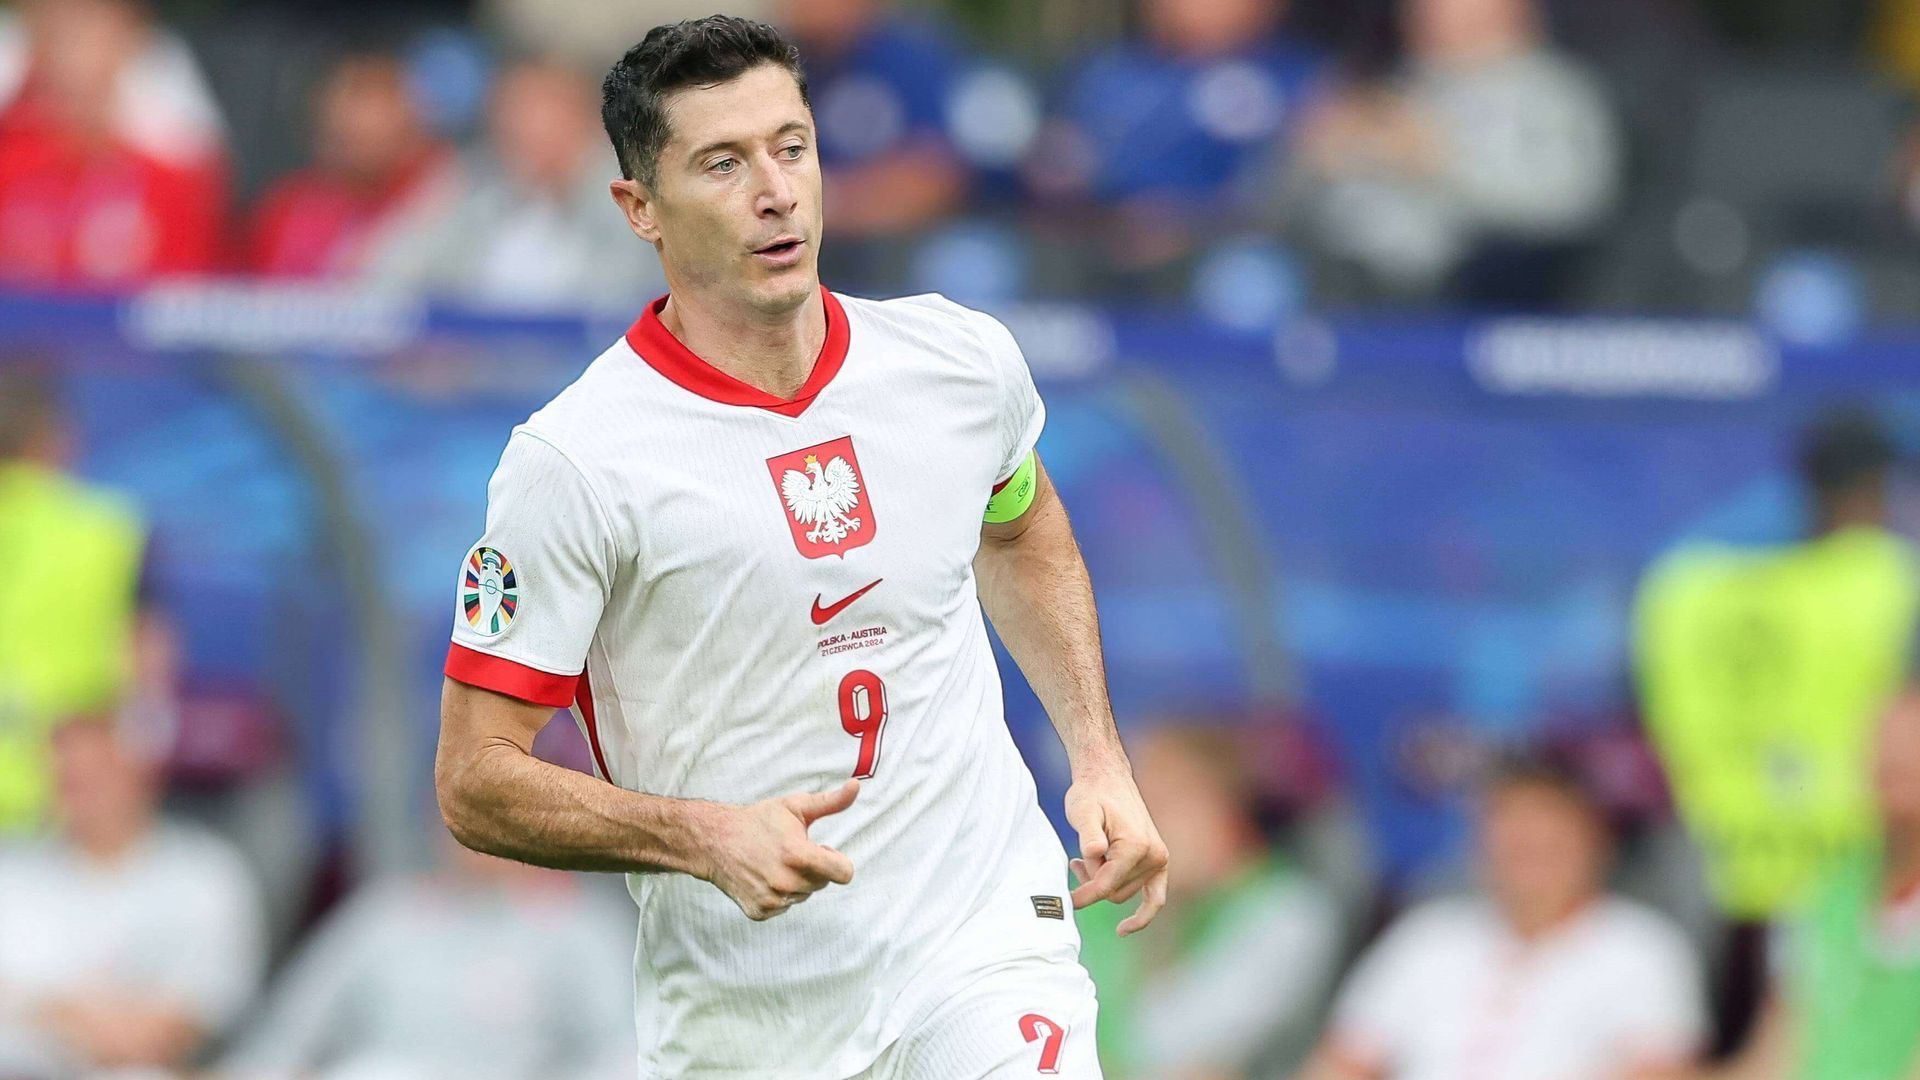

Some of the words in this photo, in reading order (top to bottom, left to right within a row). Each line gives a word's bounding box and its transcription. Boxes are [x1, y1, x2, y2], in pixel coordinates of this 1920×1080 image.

[817, 634, 847, 650] POLSKA
[851, 626, 887, 640] AUSTRIA
[821, 649, 829, 657] 21
[829, 641, 864, 655] CZERWCA
[864, 638, 884, 648] 2024
[838, 669, 888, 780] 9
